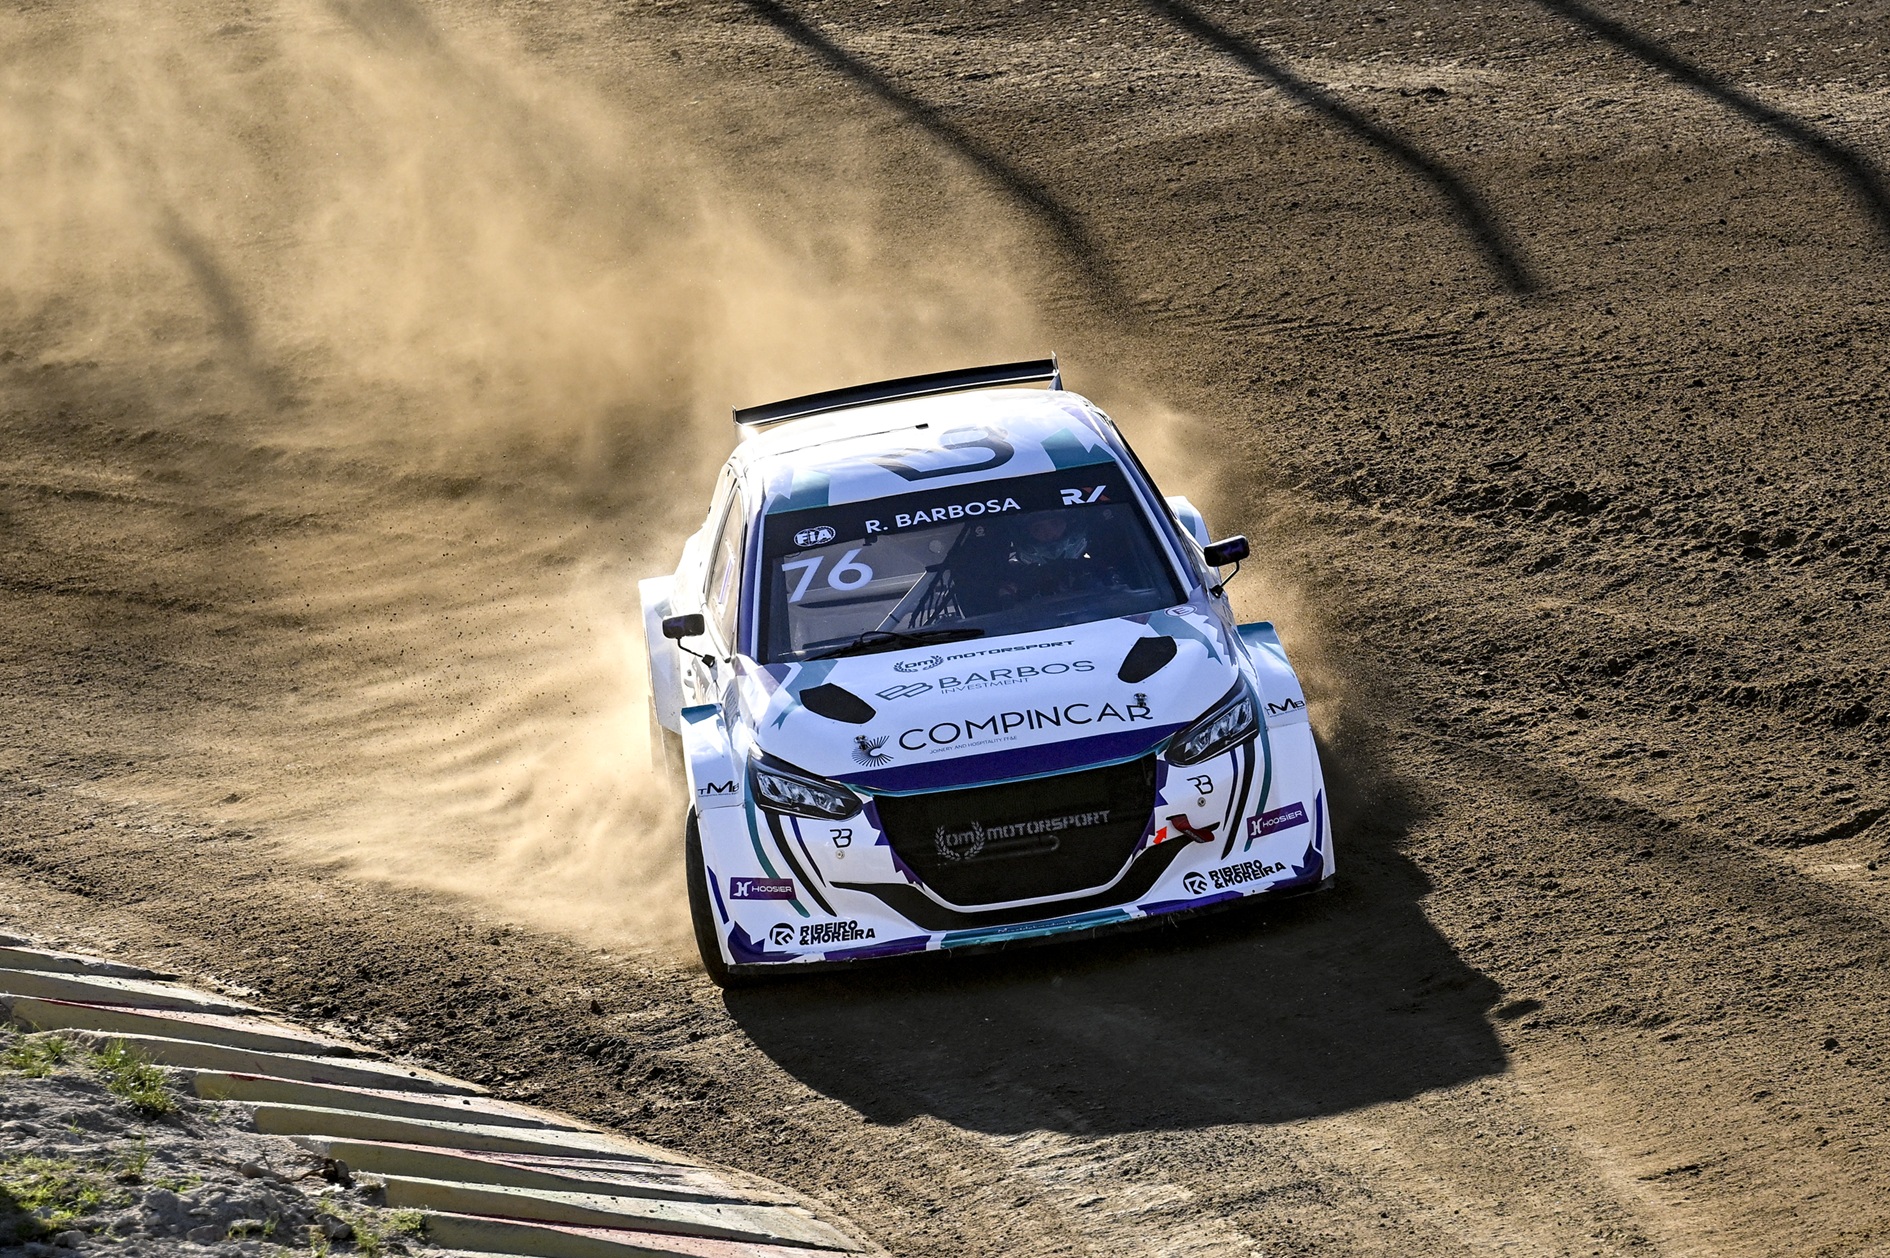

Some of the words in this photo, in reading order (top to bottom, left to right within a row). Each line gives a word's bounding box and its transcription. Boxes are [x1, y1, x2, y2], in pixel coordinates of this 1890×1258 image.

[865, 519, 888, 534] R.
[895, 497, 1021, 528] BARBOSA
[781, 548, 873, 604] 76
[947, 640, 1075, 661] MOTORSPORT
[938, 660, 1095, 690] BARBOS
[941, 678, 1030, 695] INVESTMENT
[899, 702, 1154, 751] COMPINCAR
[930, 746, 953, 754] JOINERY
[968, 738, 1002, 747] HOSPITALITY
[986, 810, 1111, 841] MOTORSPORT
[1262, 810, 1303, 828] HOOSIER
[1208, 859, 1263, 881] RIBEIRO
[751, 885, 793, 893] HOOSIER
[800, 920, 858, 937] RIBEIRO
